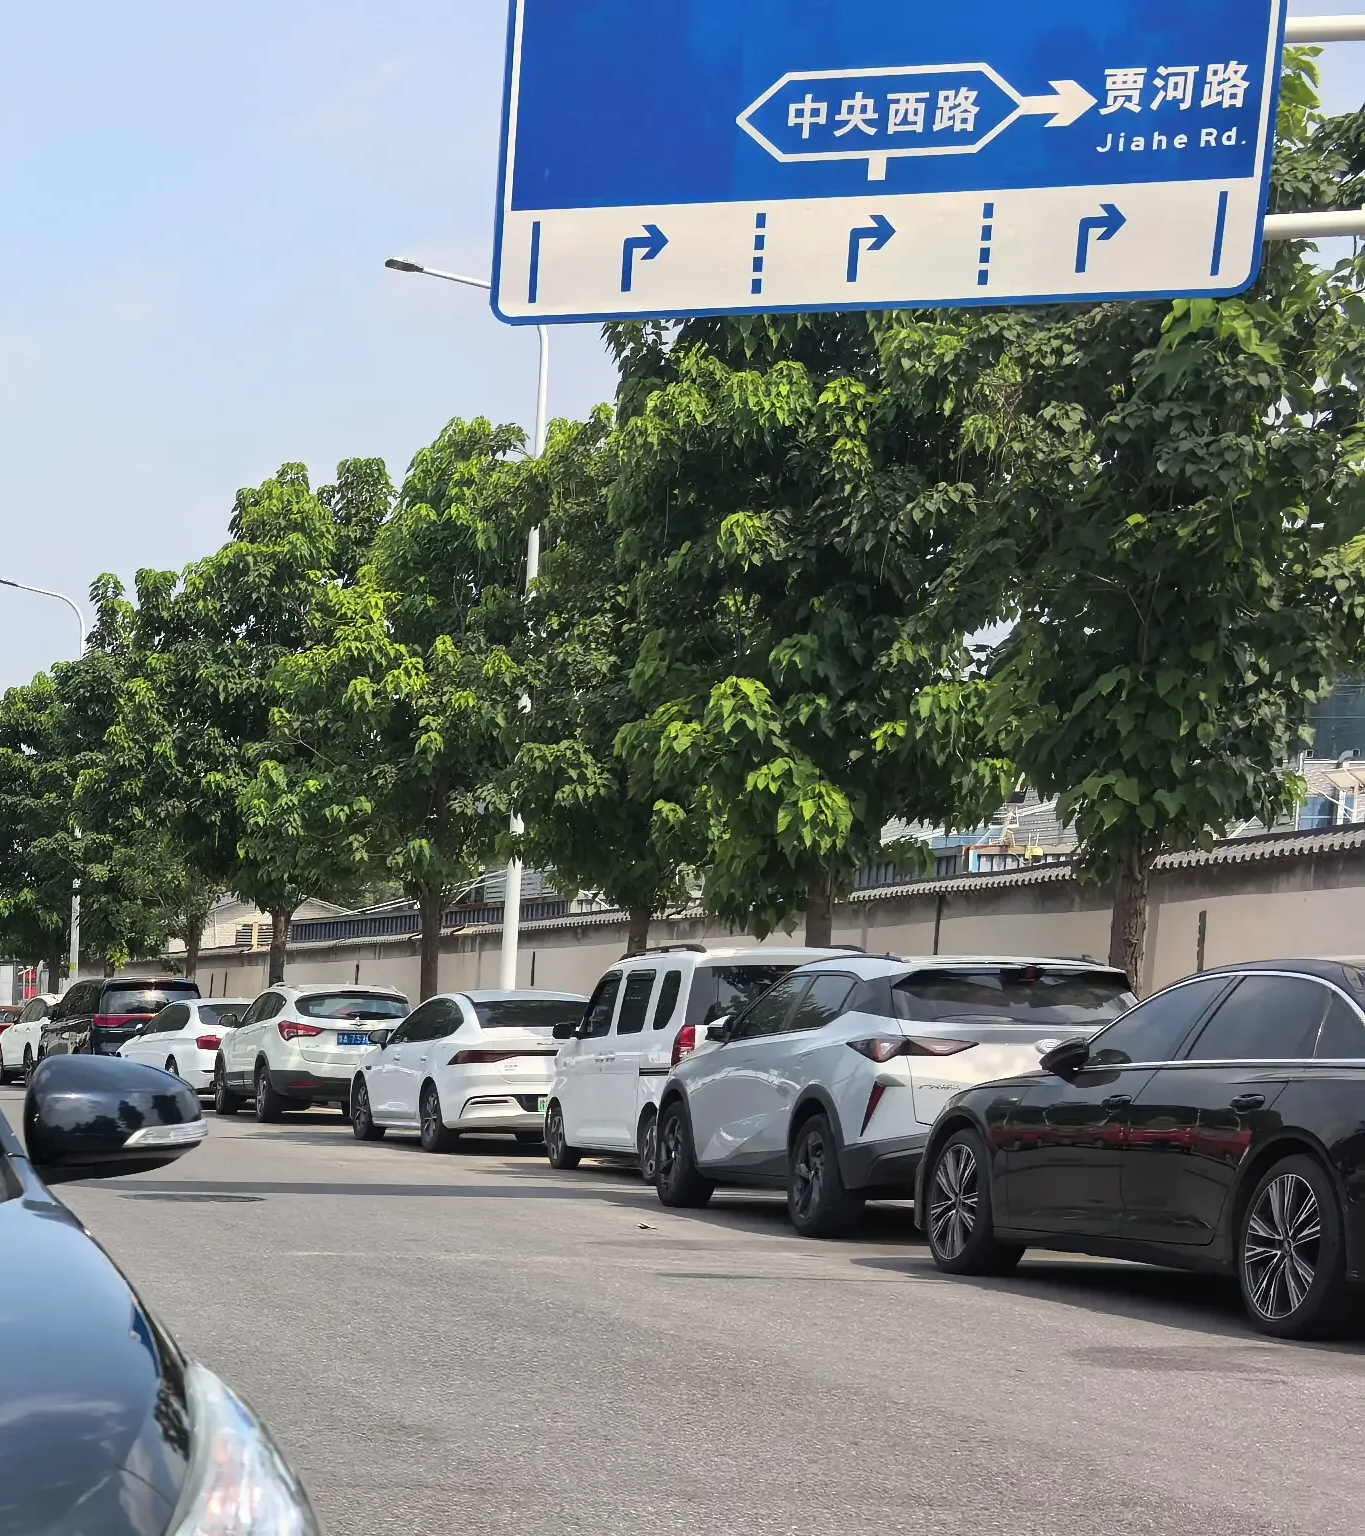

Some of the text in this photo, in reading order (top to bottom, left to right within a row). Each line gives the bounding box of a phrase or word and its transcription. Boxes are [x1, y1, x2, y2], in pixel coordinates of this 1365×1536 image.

[787, 86, 981, 139] 中央西路
[1098, 60, 1250, 116] 贾河路
[1096, 126, 1247, 153] Jiahe Rd.
